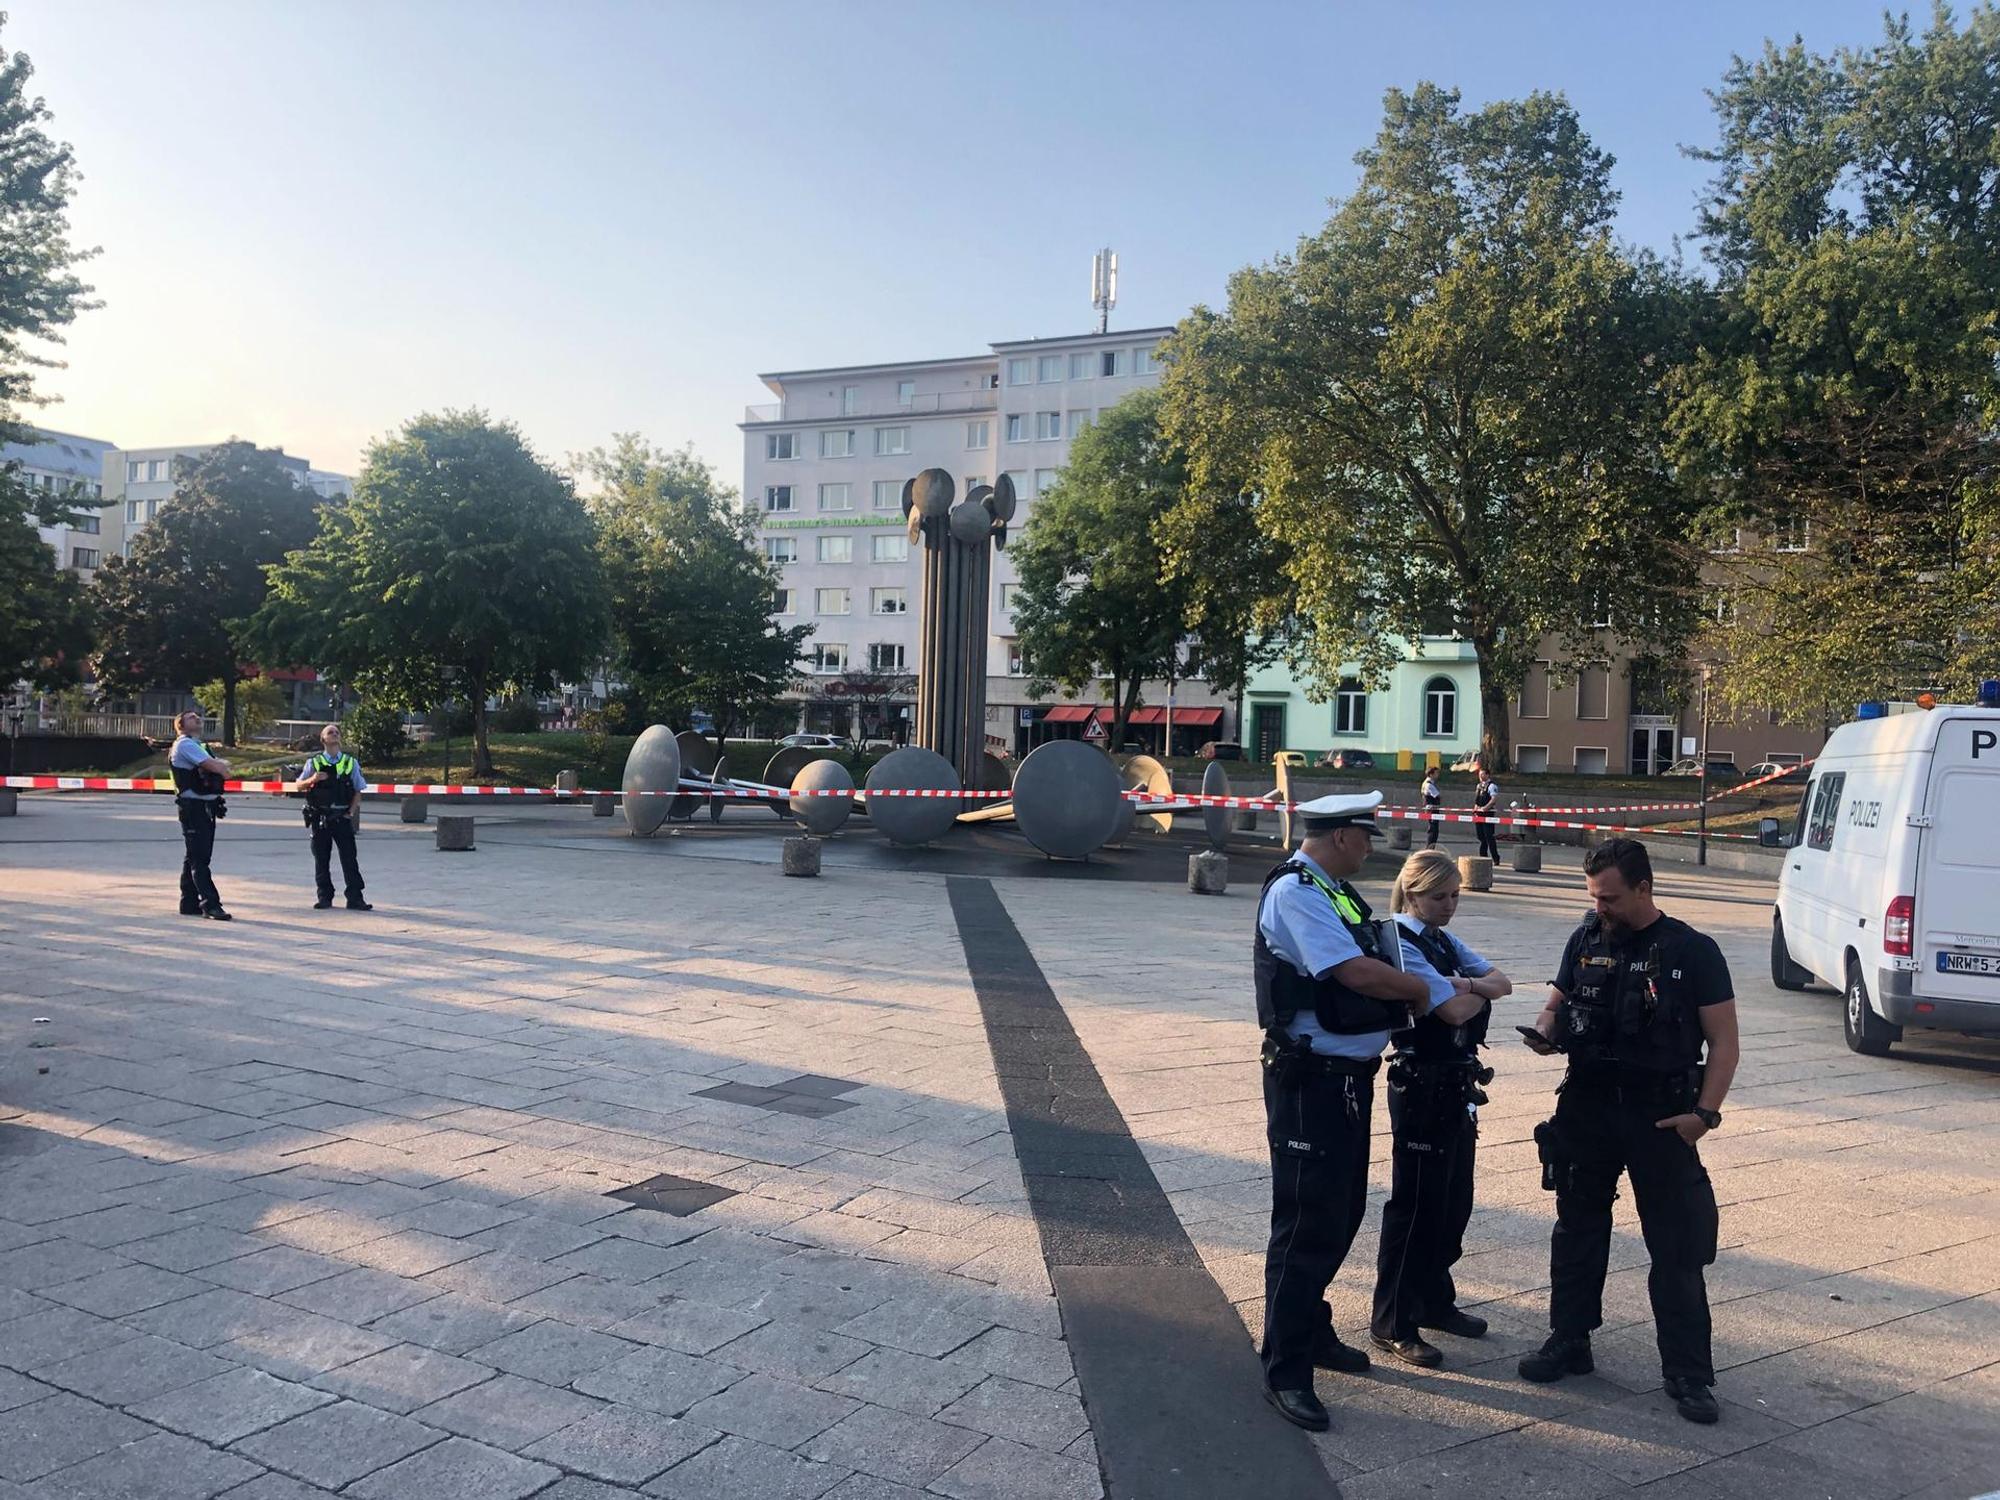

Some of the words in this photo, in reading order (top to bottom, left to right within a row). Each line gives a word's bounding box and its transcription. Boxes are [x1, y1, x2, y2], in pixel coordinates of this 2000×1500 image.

[1972, 730, 1997, 759] P
[1848, 800, 1882, 828] POLIZEI
[1947, 955, 1972, 970] NRW
[1288, 1140, 1311, 1151] POLIZEI
[1407, 1141, 1431, 1151] POLIZEI
